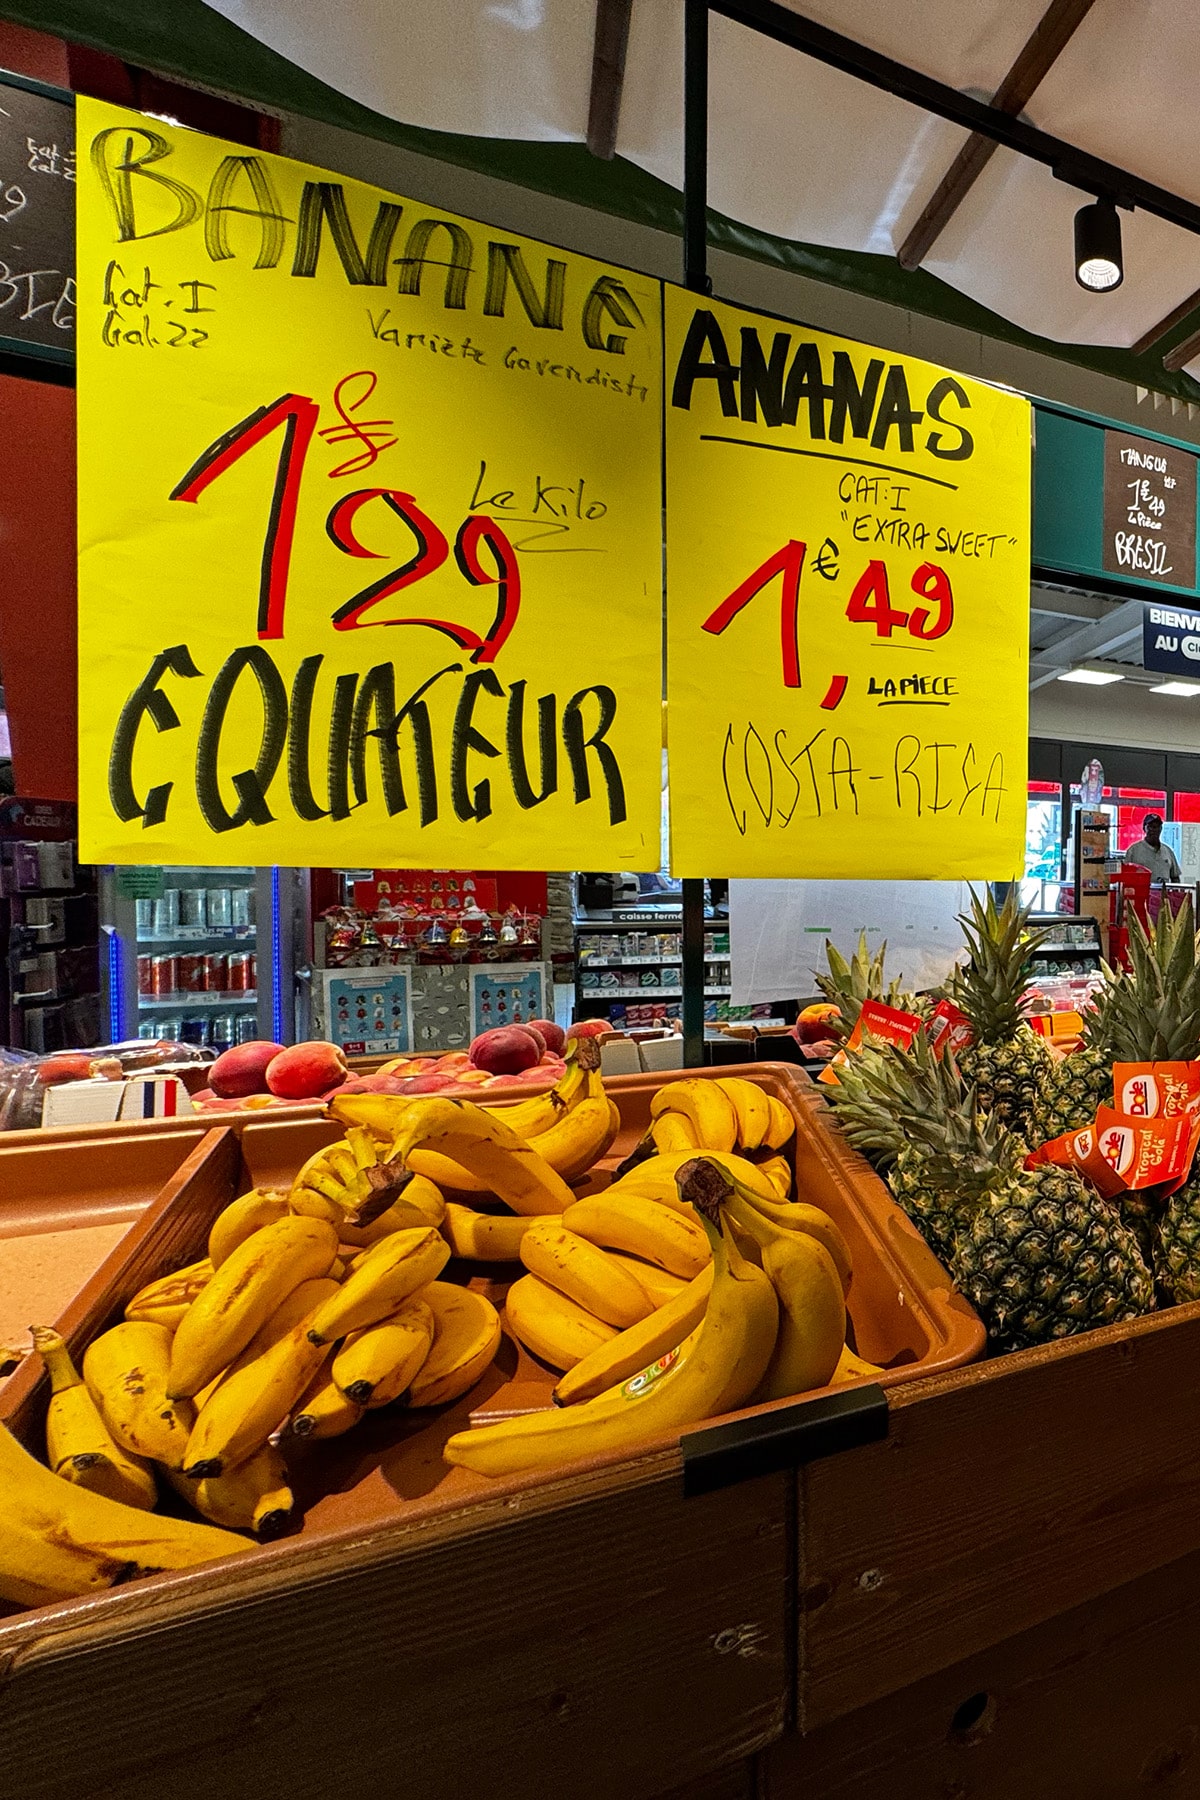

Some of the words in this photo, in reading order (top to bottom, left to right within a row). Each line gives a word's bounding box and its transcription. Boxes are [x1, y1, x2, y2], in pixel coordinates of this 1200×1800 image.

[91, 126, 645, 355] BANANE
[672, 308, 975, 461] ANANAS
[533, 479, 608, 521] Kilo
[1155, 635, 1178, 652] AU
[867, 677, 897, 696] LA
[108, 644, 627, 834] EQUATEUR
[619, 912, 653, 920] caisse
[1129, 1081, 1145, 1116] Dole
[1135, 1129, 1154, 1180] Tropical
